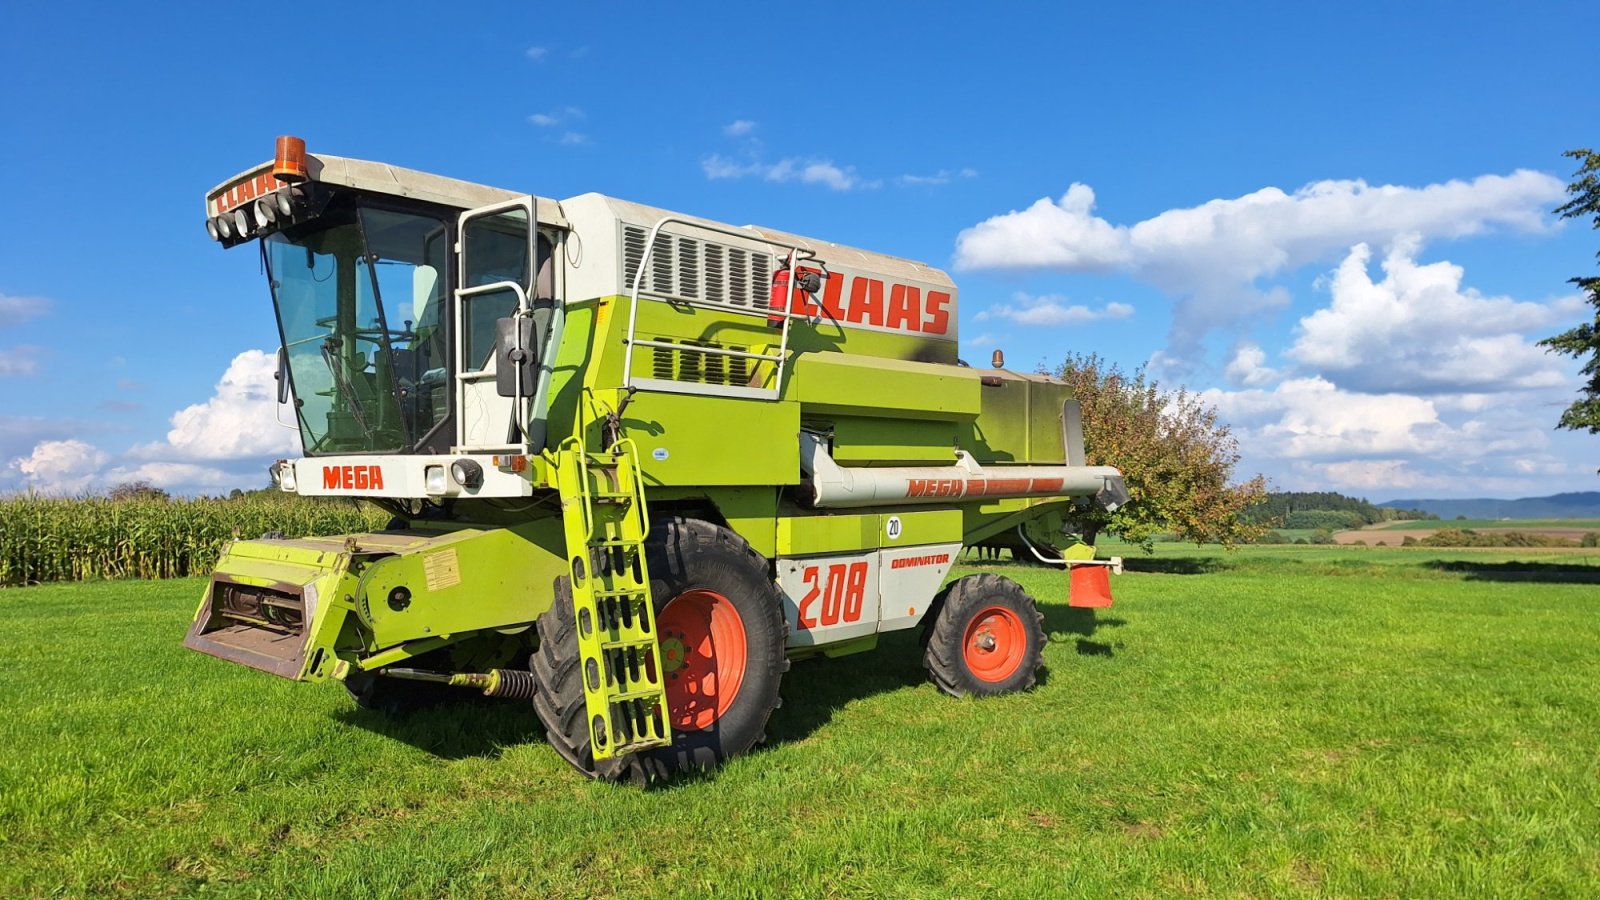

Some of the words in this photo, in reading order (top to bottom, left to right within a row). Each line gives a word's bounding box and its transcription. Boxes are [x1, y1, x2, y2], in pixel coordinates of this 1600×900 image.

[216, 172, 287, 213] CLAA
[323, 465, 384, 490] MEGA
[906, 479, 963, 497] MEGA
[889, 519, 899, 536] 20
[891, 554, 950, 569] DOMINATOR
[797, 562, 868, 630] 208
